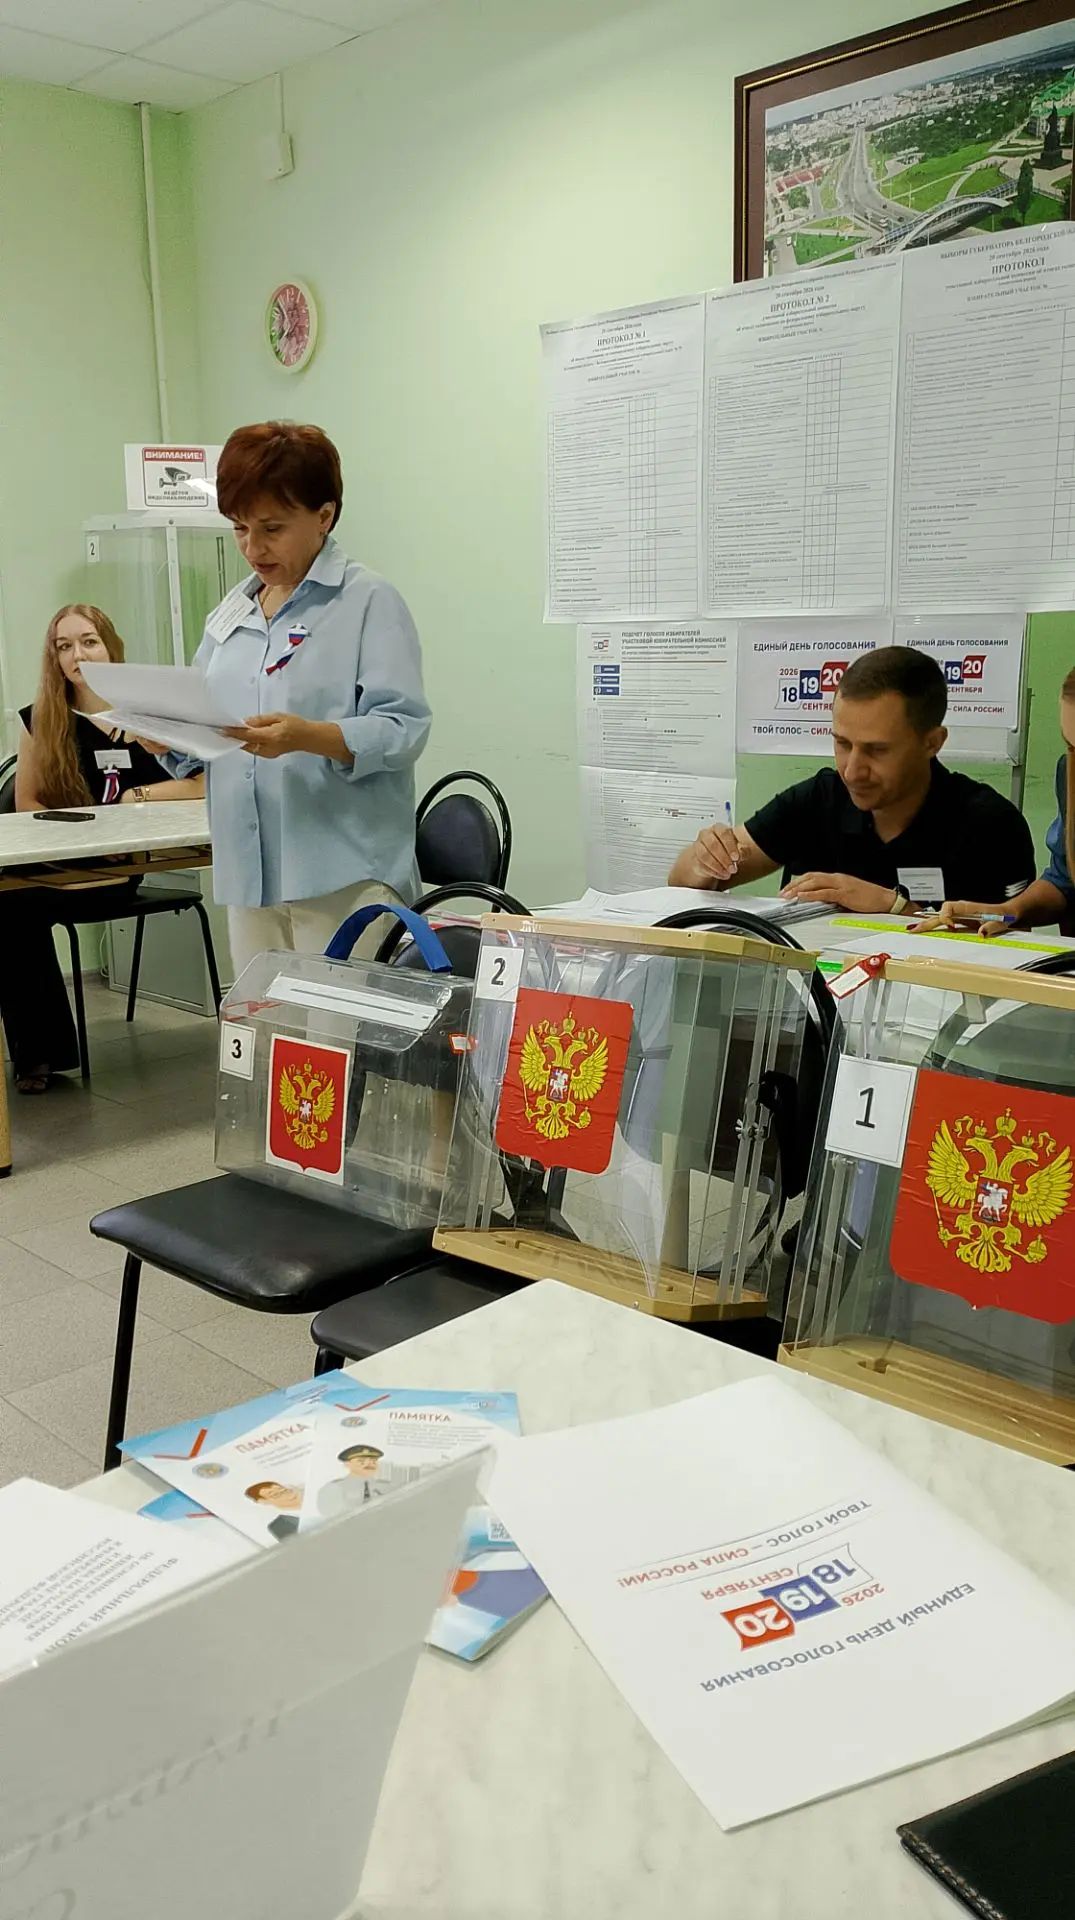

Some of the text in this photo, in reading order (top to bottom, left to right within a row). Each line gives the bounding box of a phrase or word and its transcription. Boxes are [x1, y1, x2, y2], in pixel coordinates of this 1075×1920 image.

[991, 257, 1045, 275] ПРОТОКОЛ
[770, 297, 814, 313] ПРОТОКОЛ
[145, 451, 203, 460] ВНИМАНИЕ!
[90, 542, 96, 556] 2
[753, 640, 876, 652] ЕДИНЫЙ ДЕНЬ ГОЛОСОВАНИЯ
[906, 638, 936, 647] ЕДИНЫЙ
[936, 639, 955, 647] ДЕНЬ
[779, 668, 799, 676] 2026
[946, 666, 961, 680] 19
[964, 660, 982, 674] 20
[801, 676, 819, 694] 19
[822, 668, 844, 686] 20
[781, 686, 798, 703] 18
[947, 686, 983, 694] СЕНТЯБРЯ
[802, 702, 833, 711] СЕНТЯБ
[952, 705, 972, 713] СИЛА
[753, 724, 774, 734] ТВОЙ
[775, 726, 802, 735] ГОЛОС
[490, 957, 507, 987] 2
[230, 1038, 243, 1060] 3
[854, 1086, 877, 1130] 1
[389, 1411, 452, 1423] ПАМЯТКА
[235, 1423, 310, 1454] ПАМЯТКА
[824, 1500, 873, 1526] ТВОЙ
[766, 1519, 825, 1548] ГОЛОС
[700, 1547, 749, 1566] СИЛА
[616, 1560, 700, 1589] РОССИИ!
[811, 1558, 857, 1585] 18
[87, 1557, 179, 1622] ФЕДЕРАЛЬНЫЙ
[700, 1566, 795, 1601] СЕНТЯБРЯ
[778, 1583, 827, 1612] 19
[841, 1583, 885, 1607] 2026
[733, 1605, 790, 1639] 20
[699, 1582, 976, 1693] ЕДИНЫЙ ДЕНЬ ГОЛОСОВАНИЯ
